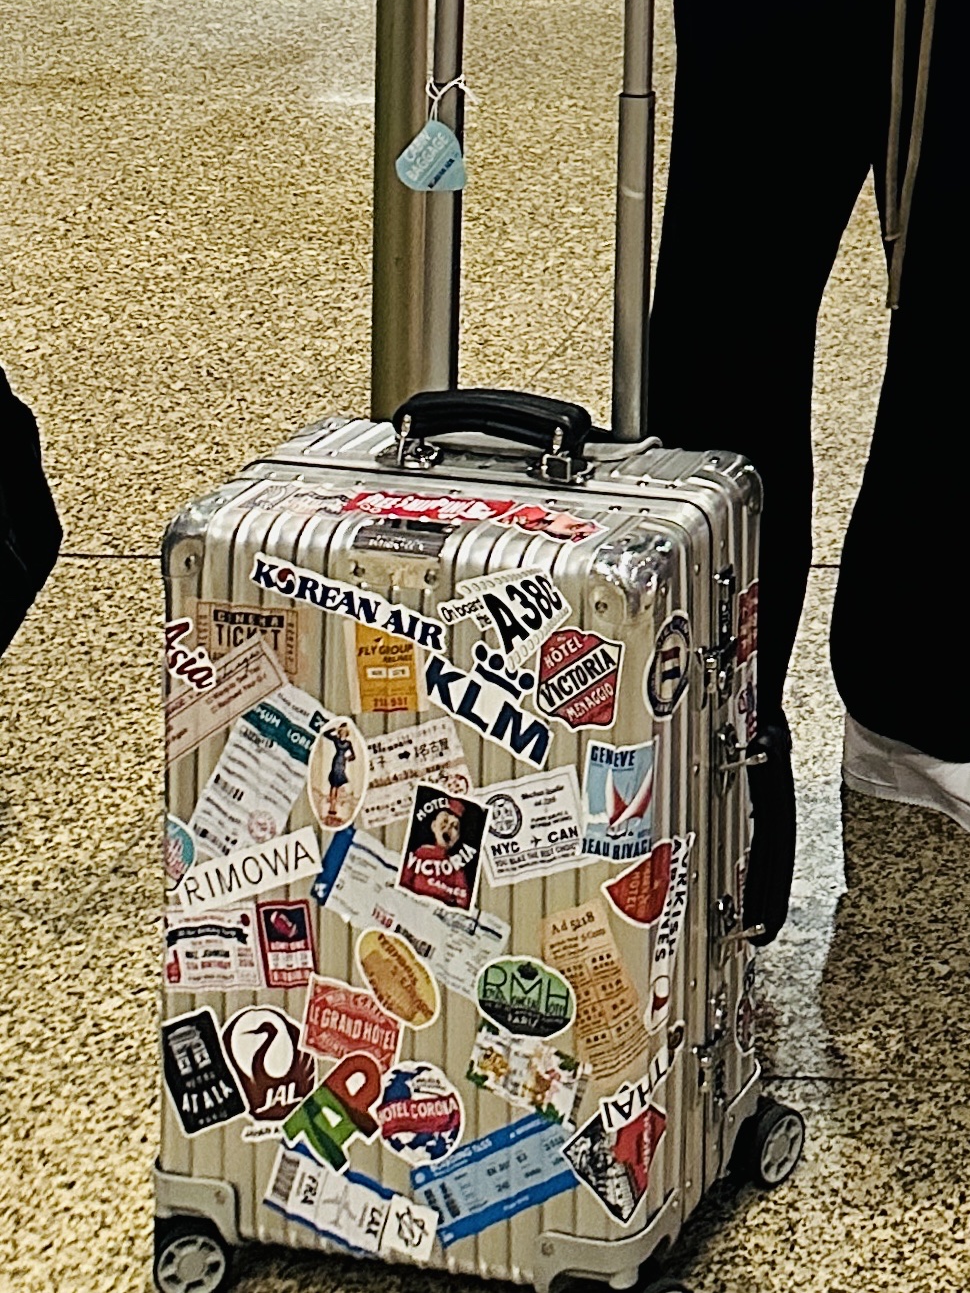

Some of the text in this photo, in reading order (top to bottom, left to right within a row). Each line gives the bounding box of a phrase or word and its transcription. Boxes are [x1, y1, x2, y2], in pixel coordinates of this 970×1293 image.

[406, 131, 450, 182] BAGGAGE
[252, 558, 446, 651] KOREAN AIR
[441, 597, 485, 624] On board
[215, 623, 281, 651] TICKT
[538, 645, 617, 704] VICTORIA
[425, 656, 552, 766] KLM
[590, 745, 637, 766] GENEVE
[407, 843, 477, 875] VICTORIA
[490, 825, 579, 856] NYC CAN
[182, 839, 316, 905] RIMOWA
[483, 964, 570, 1017] RMH
[309, 1003, 321, 1026] LE
[320, 1007, 363, 1040] GRAND
[255, 1081, 303, 1114] JAL
